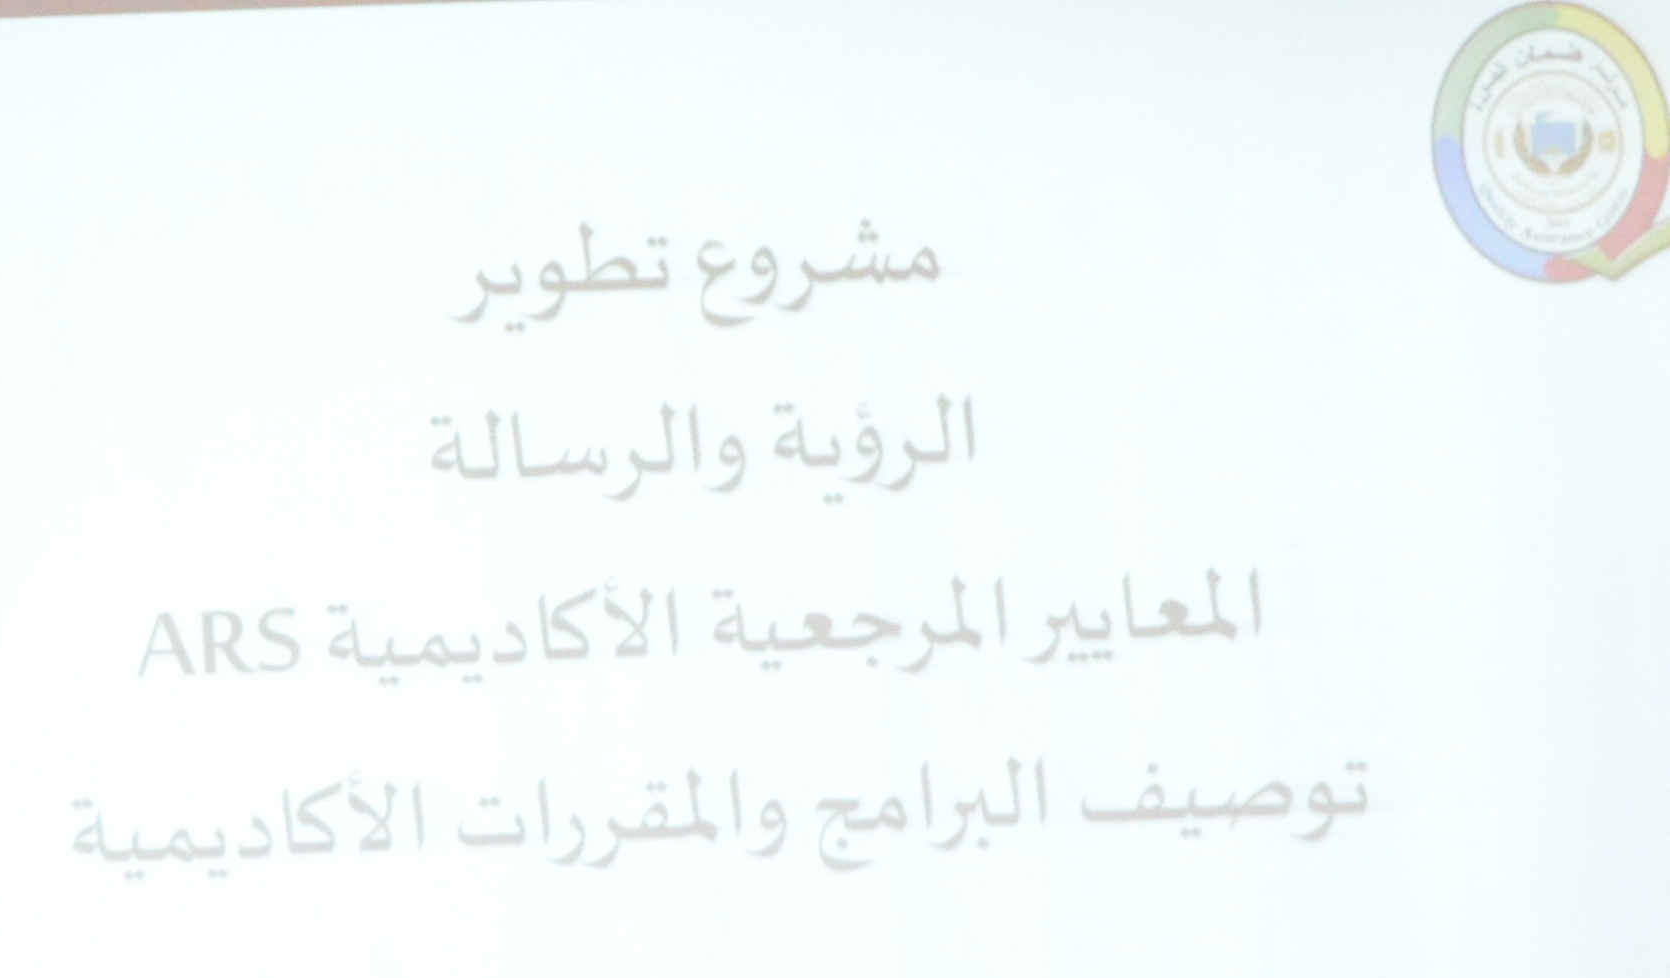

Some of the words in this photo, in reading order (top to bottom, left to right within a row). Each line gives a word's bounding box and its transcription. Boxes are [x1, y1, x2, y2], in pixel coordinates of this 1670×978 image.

[452, 221, 670, 333] تطوير
[697, 218, 941, 329] مشروع
[429, 401, 747, 503] والرسالة
[772, 393, 976, 506] الرؤية
[137, 606, 302, 678] ARS
[326, 577, 680, 687] الأكاديمية
[711, 575, 1008, 675] المرجعية
[1026, 566, 1262, 666] المعايير
[70, 770, 426, 881] الأكاديمية
[456, 767, 789, 870] والمقررات
[815, 755, 1048, 873] البرامج
[1079, 760, 1369, 844] توصيف
